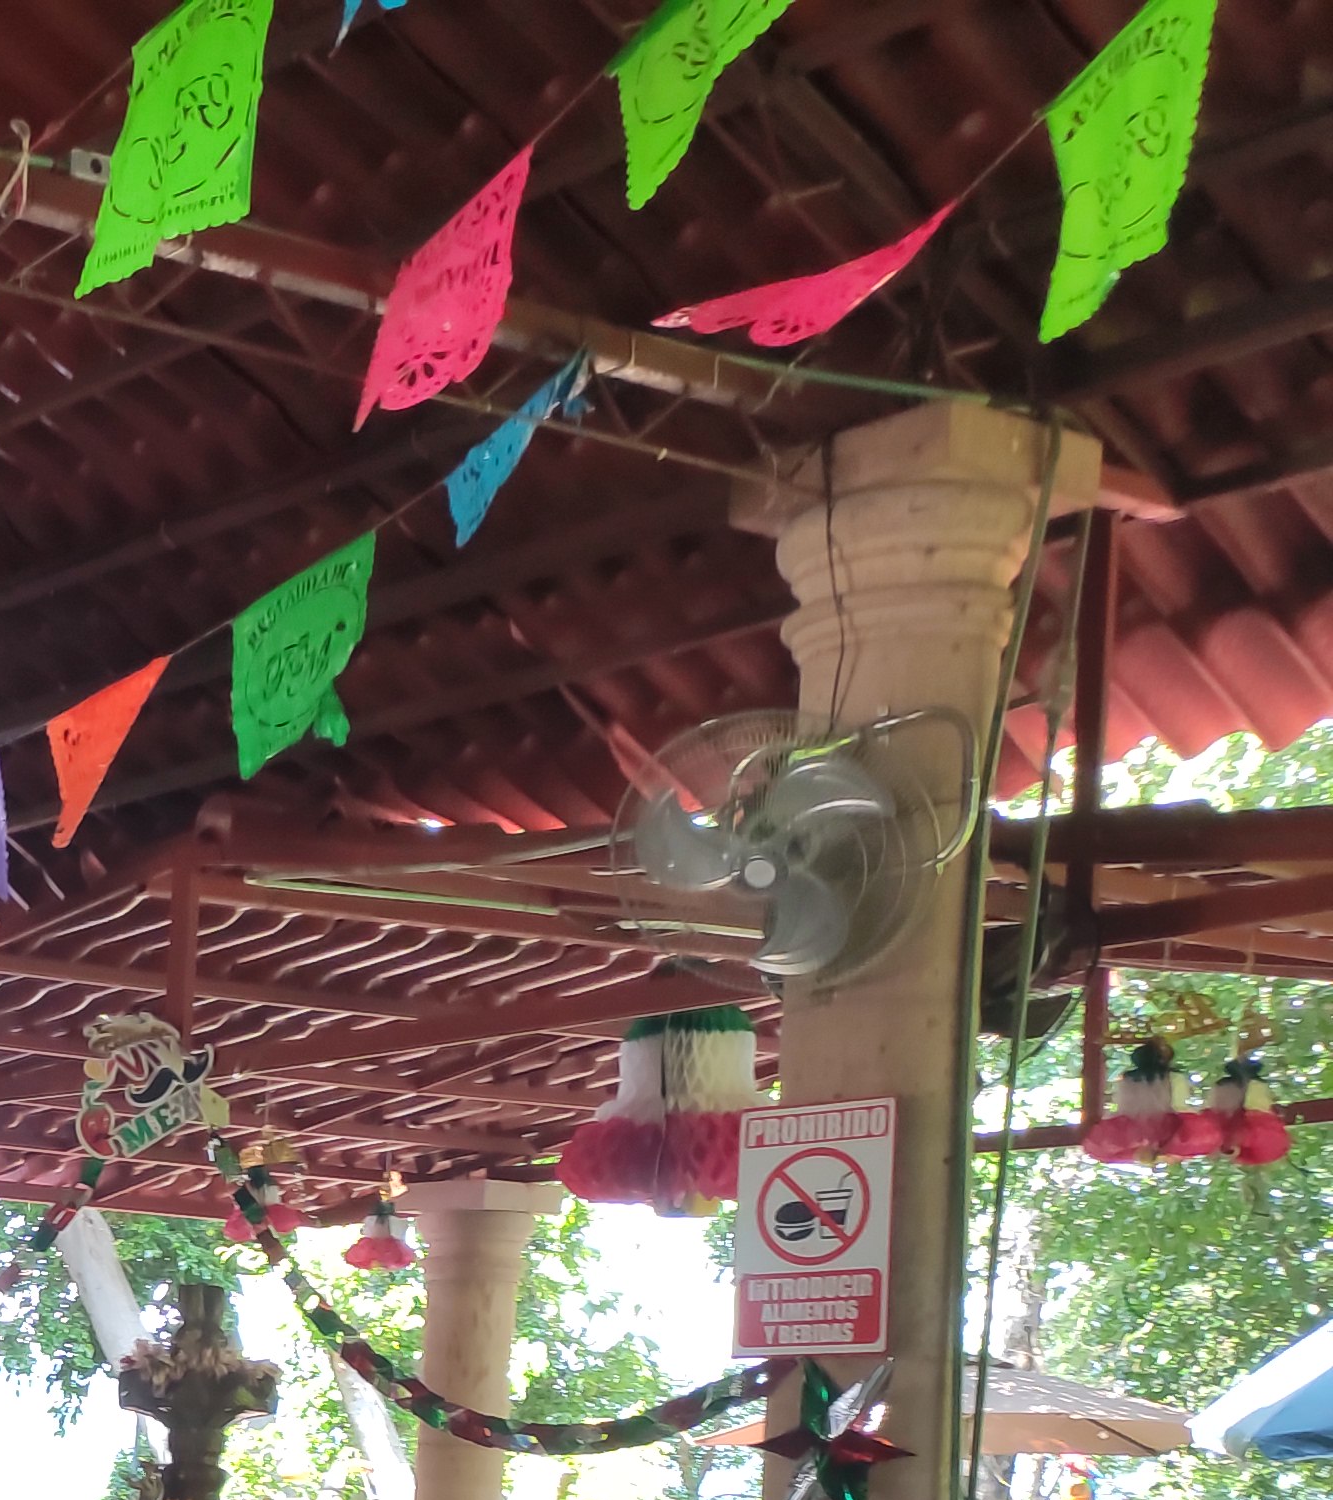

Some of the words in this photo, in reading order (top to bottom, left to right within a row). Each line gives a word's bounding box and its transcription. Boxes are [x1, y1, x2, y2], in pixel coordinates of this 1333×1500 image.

[747, 1107, 887, 1147] PROHIBIDO
[748, 1274, 874, 1302] INTRODUCIR
[761, 1300, 859, 1323] ALIMENTOS
[763, 1325, 777, 1345] Y
[778, 1322, 855, 1345] BEBIDAS
